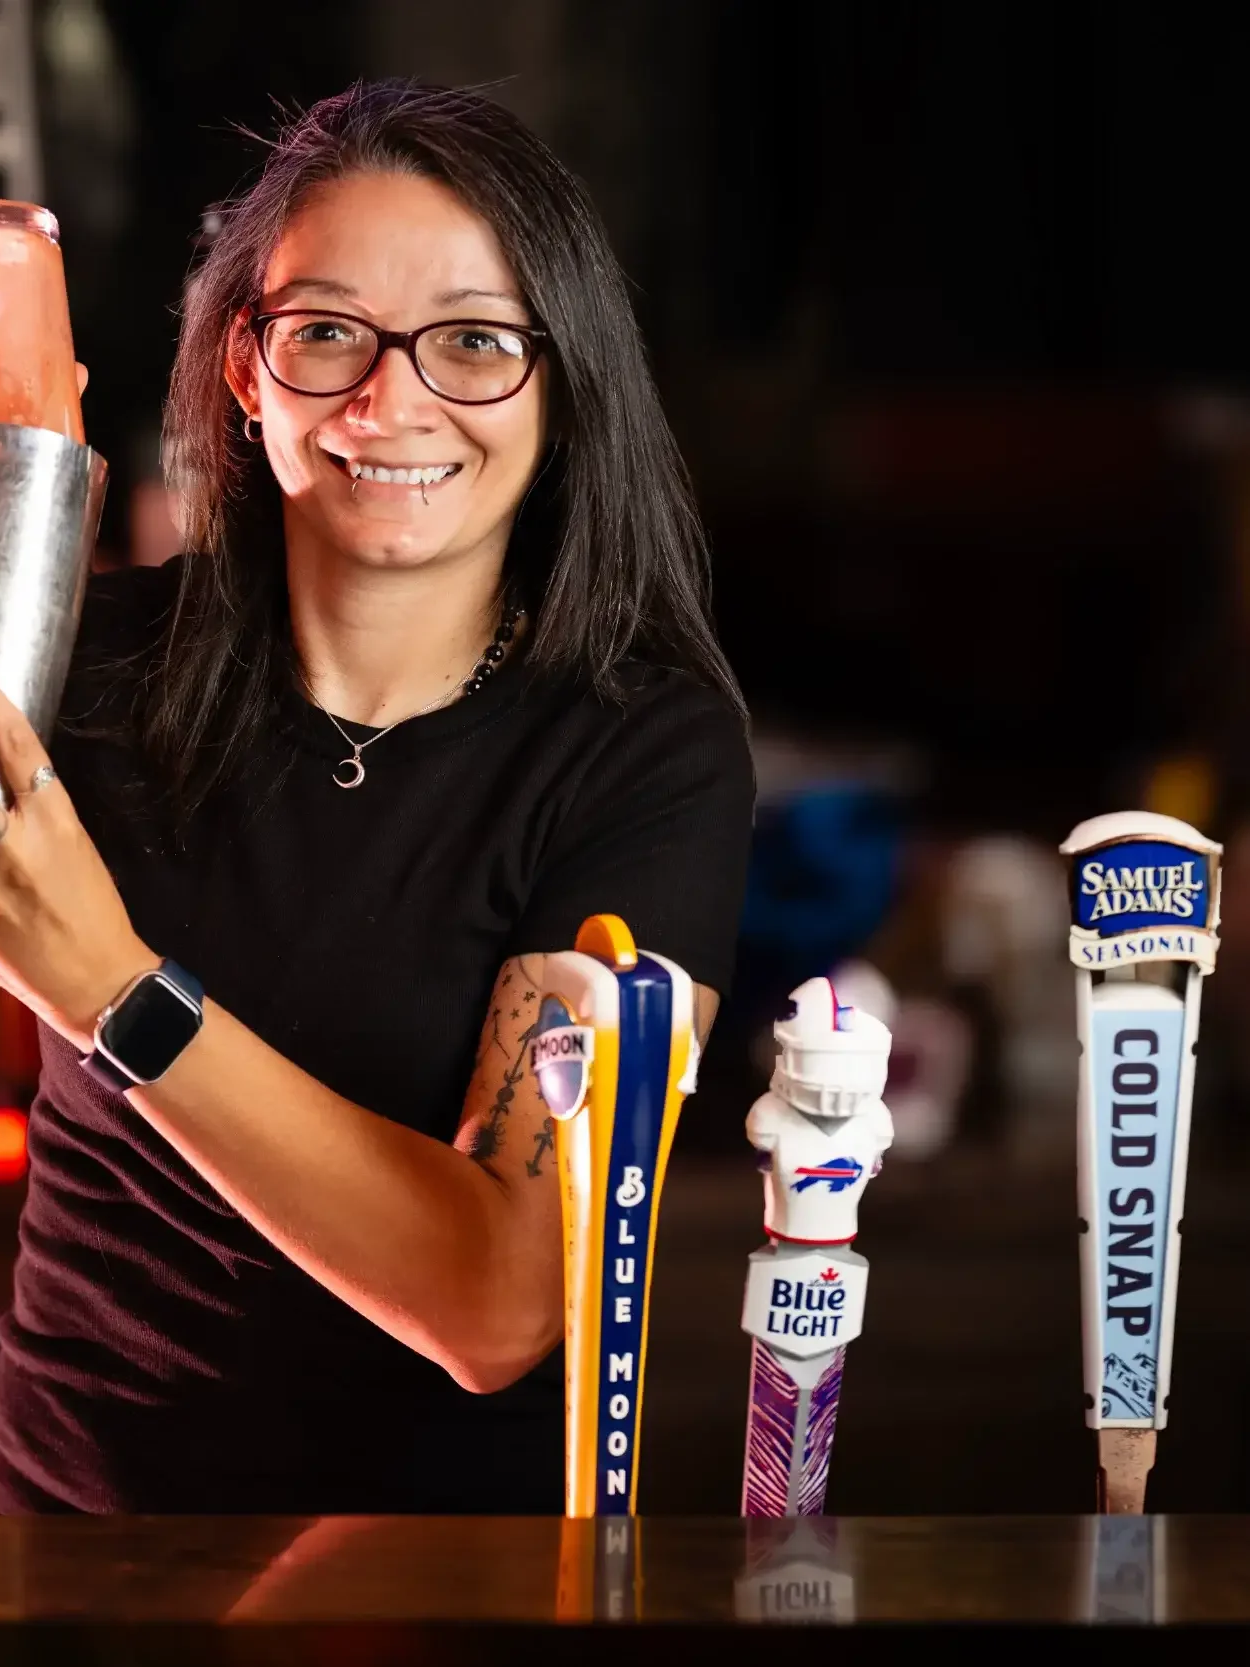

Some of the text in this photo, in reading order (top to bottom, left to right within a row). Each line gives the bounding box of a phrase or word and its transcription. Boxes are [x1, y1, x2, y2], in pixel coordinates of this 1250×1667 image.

[1082, 861, 1203, 895] SAMUEL
[1082, 936, 1195, 963] SEASONAL
[1106, 1029, 1159, 1337] COLD SNAP
[614, 1166, 646, 1323] BLUE
[771, 1279, 846, 1311] Blue
[767, 1311, 843, 1337] LIGHT
[607, 1352, 633, 1496] MOON
